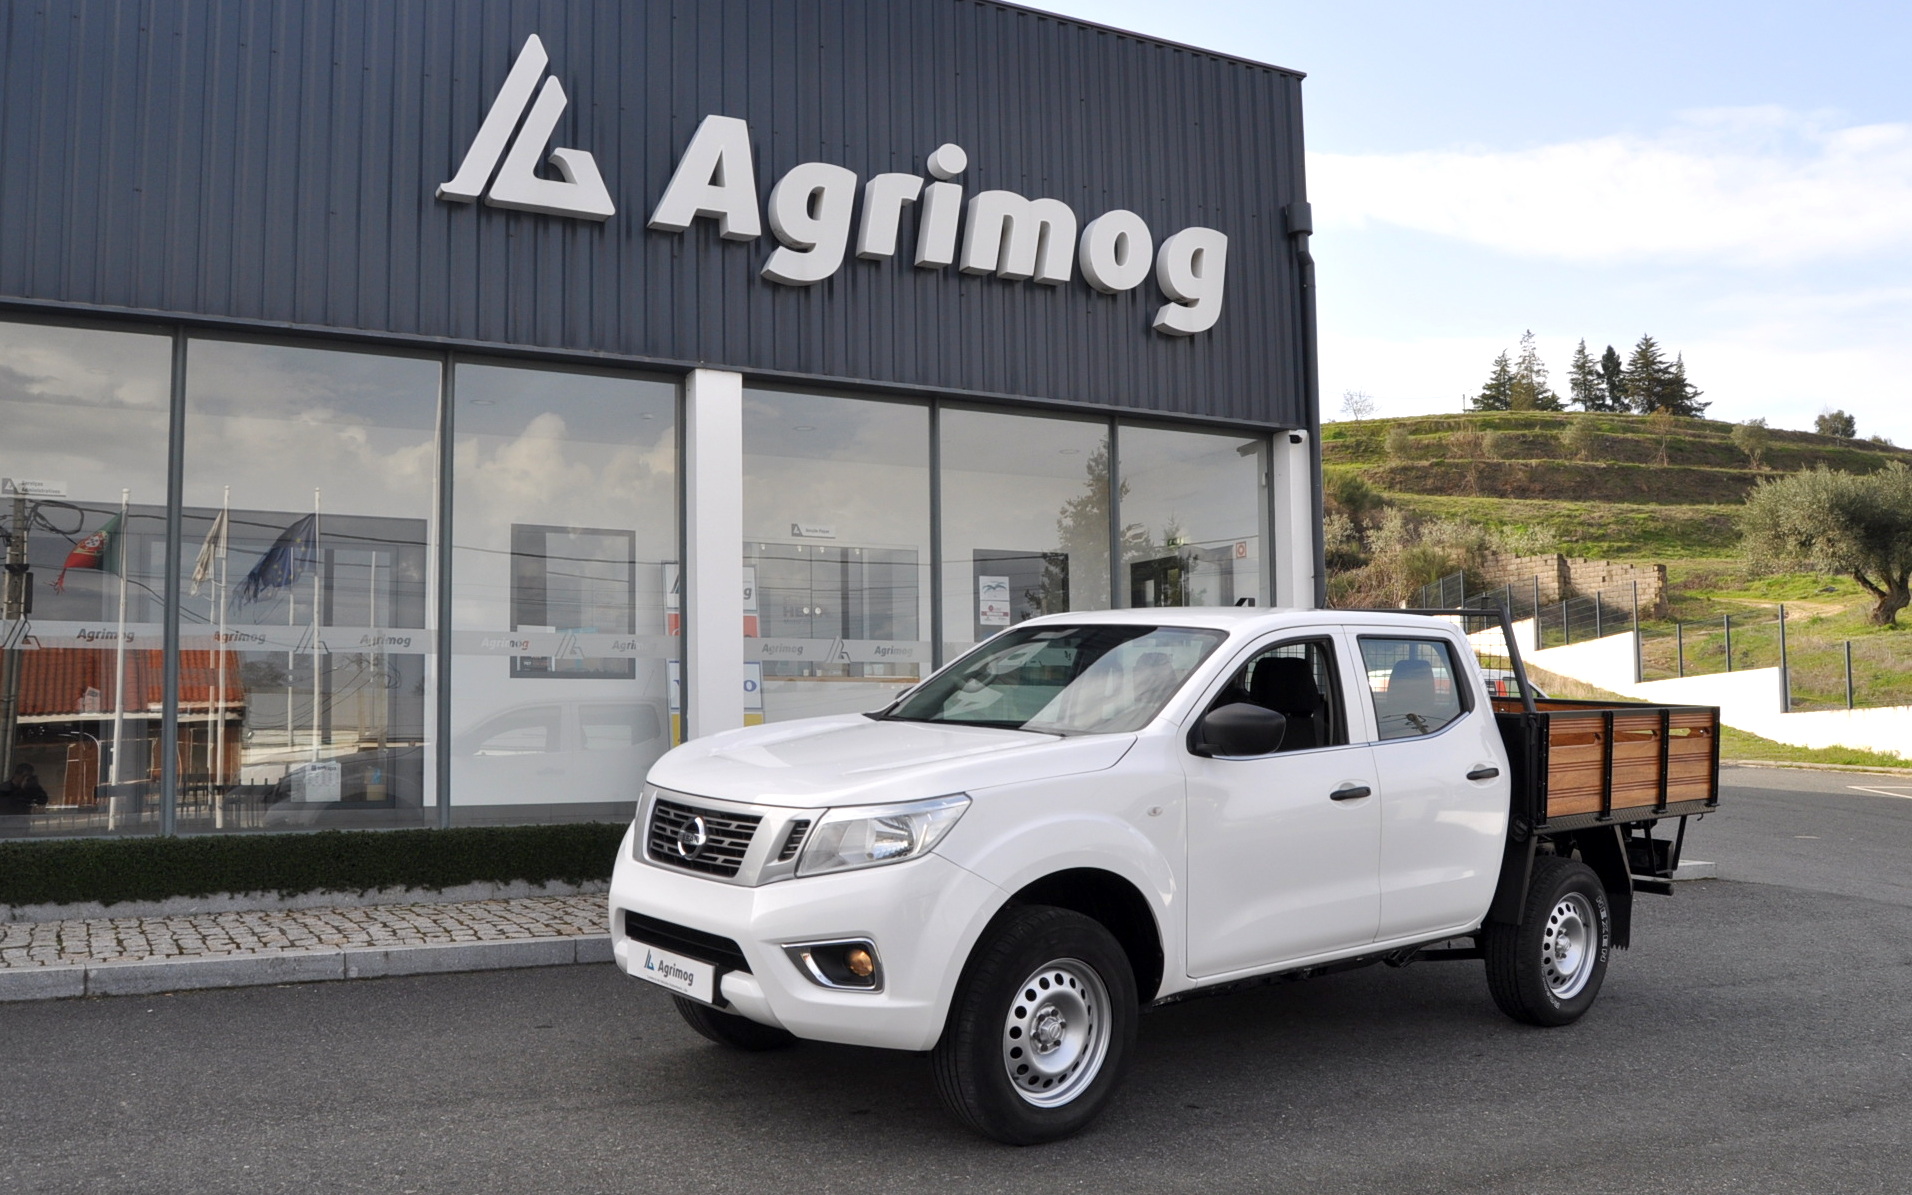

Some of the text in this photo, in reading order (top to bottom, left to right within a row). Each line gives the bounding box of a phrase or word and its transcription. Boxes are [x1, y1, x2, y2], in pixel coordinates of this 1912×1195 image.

[646, 114, 1229, 337] Agrimog
[481, 637, 530, 651] Agrimog
[762, 643, 804, 656] Agrimog
[874, 645, 914, 658] Agrimog
[1595, 895, 1609, 963] NEXEN
[657, 959, 694, 986] Agrimog
